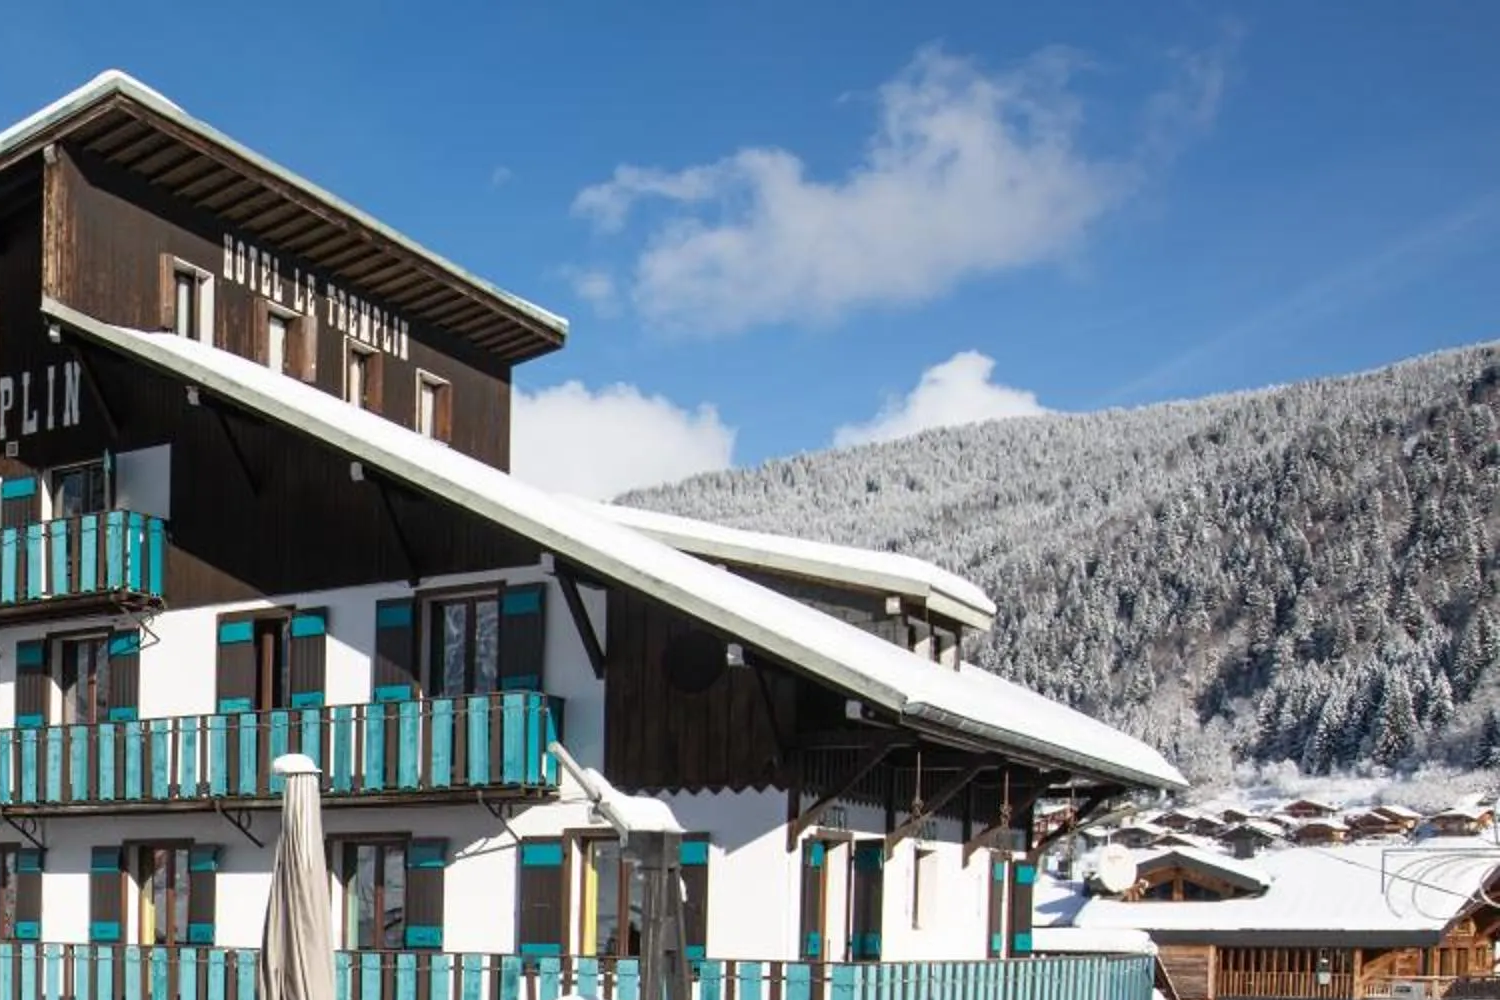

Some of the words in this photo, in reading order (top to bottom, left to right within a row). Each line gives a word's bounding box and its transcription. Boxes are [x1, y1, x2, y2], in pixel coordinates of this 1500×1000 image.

[223, 232, 283, 303] HOTEL
[293, 267, 316, 317] LE
[326, 282, 409, 362] TREMPLIN
